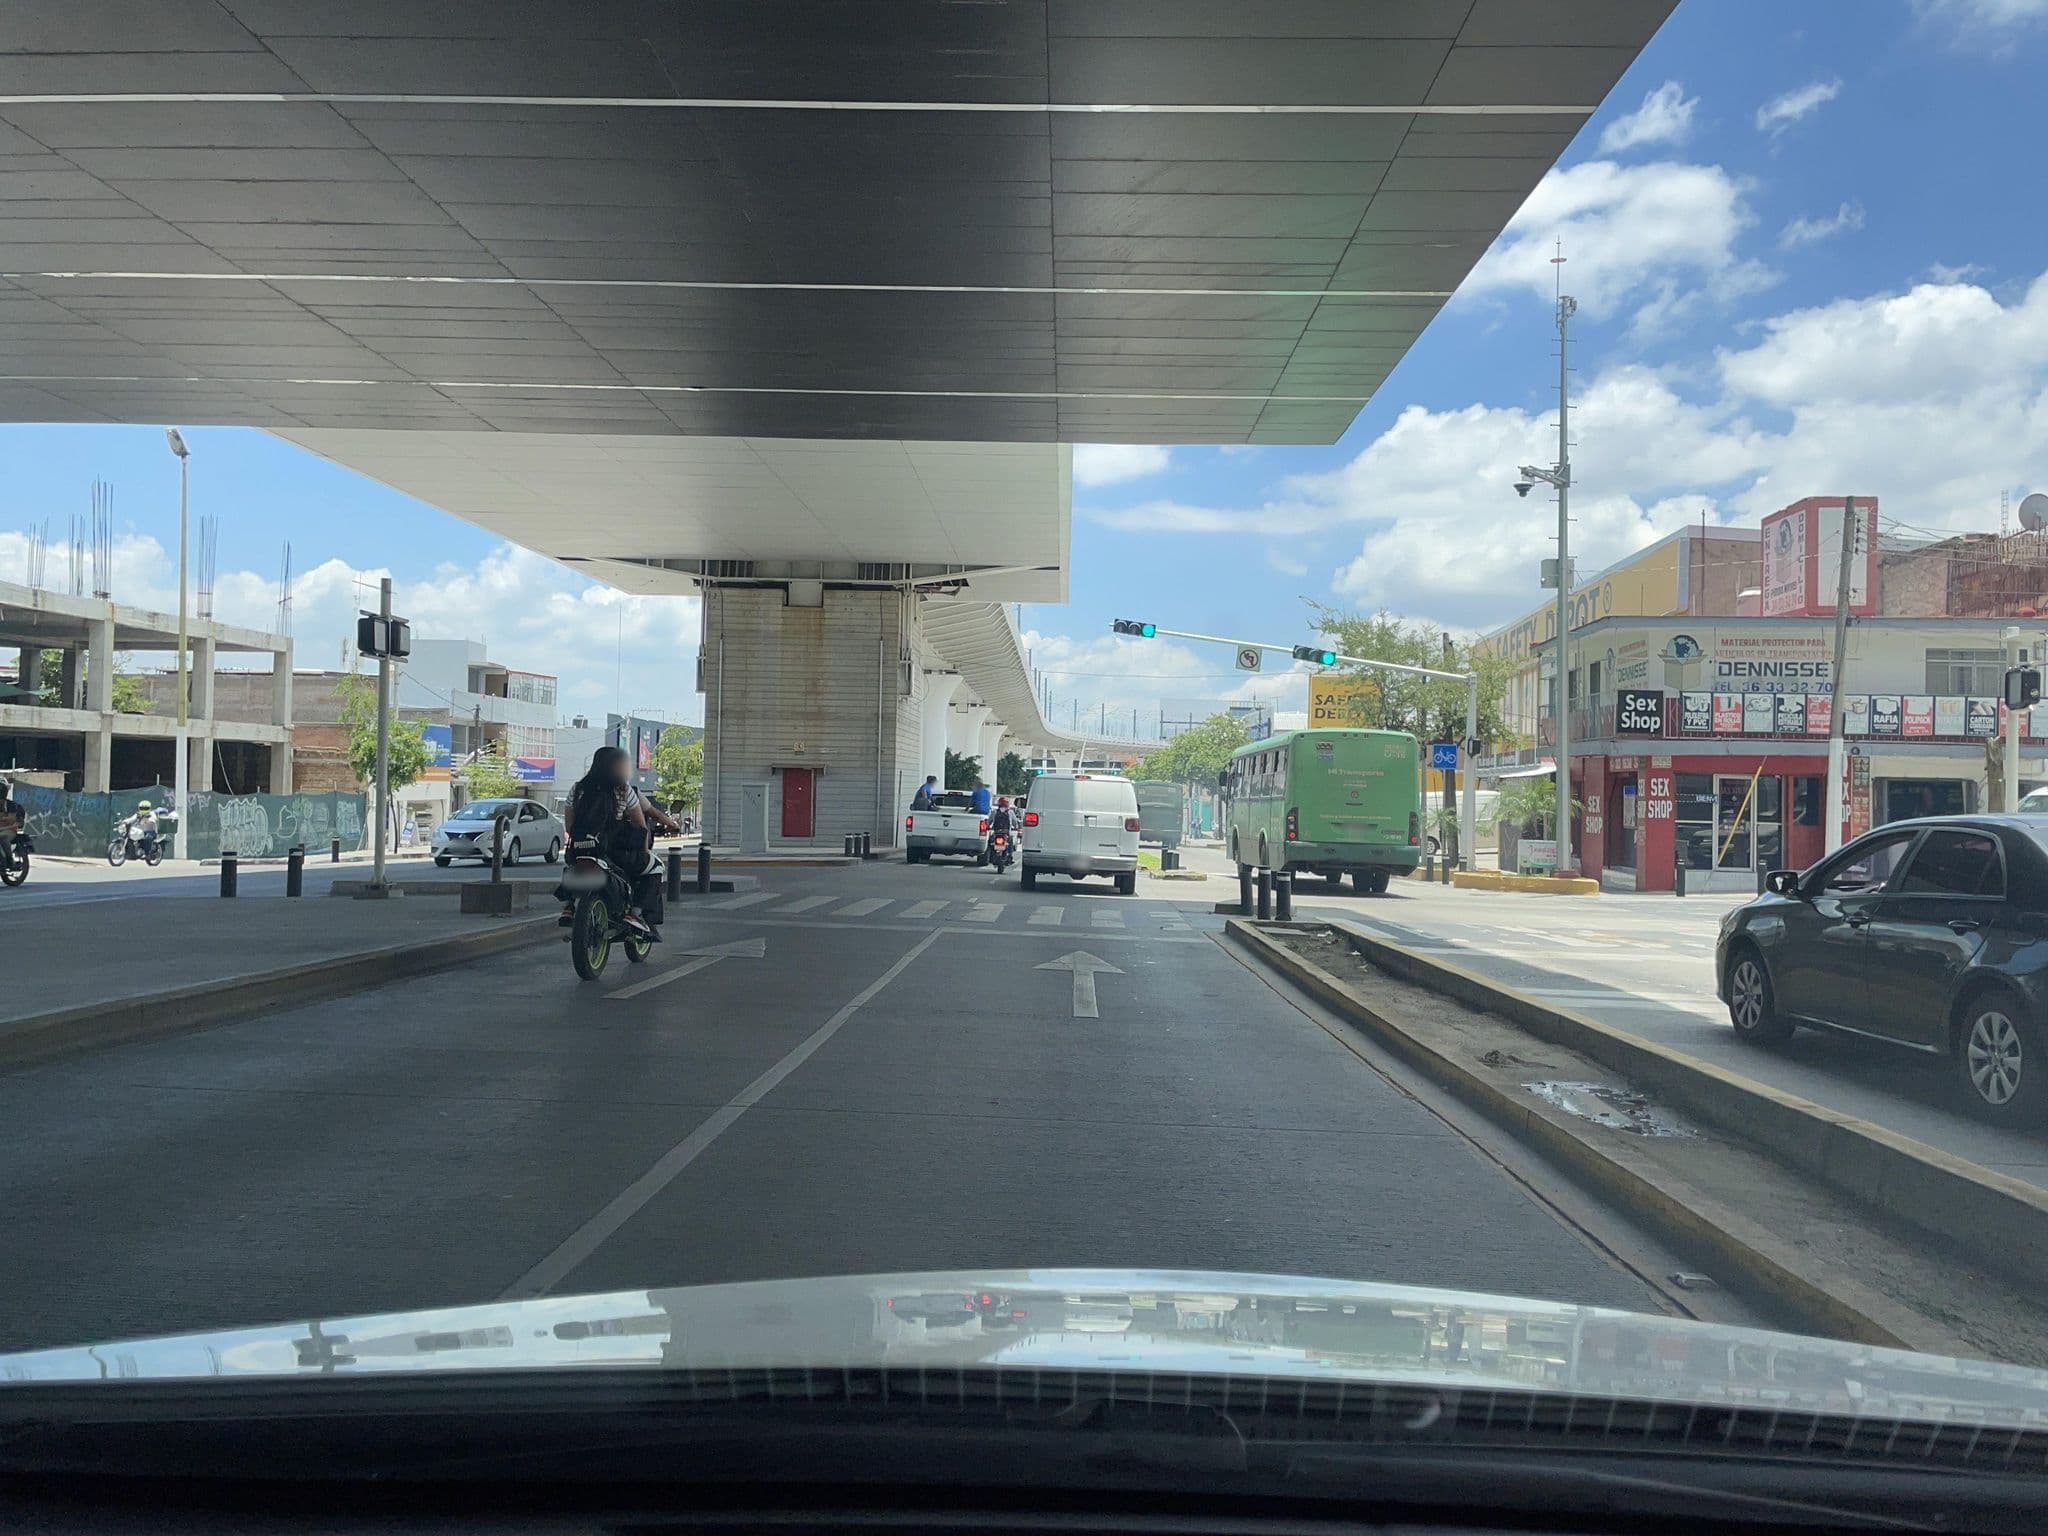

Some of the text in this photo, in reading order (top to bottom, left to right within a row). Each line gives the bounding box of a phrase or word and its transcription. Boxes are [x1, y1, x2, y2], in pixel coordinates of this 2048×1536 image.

[1546, 587, 1601, 640] DPOT
[1721, 638, 1826, 647] MATERIAL PROTECTOR PARA
[1718, 661, 1829, 678] DENNISSE
[1742, 682, 1760, 693] 36
[1766, 682, 1784, 693] 33
[1625, 694, 1657, 711] Sex
[1621, 711, 1661, 733] Shop
[1873, 715, 1898, 723] RAFIA
[1650, 777, 1670, 796] SEX
[1587, 795, 1601, 813] SEX
[1647, 800, 1673, 818] SHOP
[1585, 816, 1603, 834] SHOP
